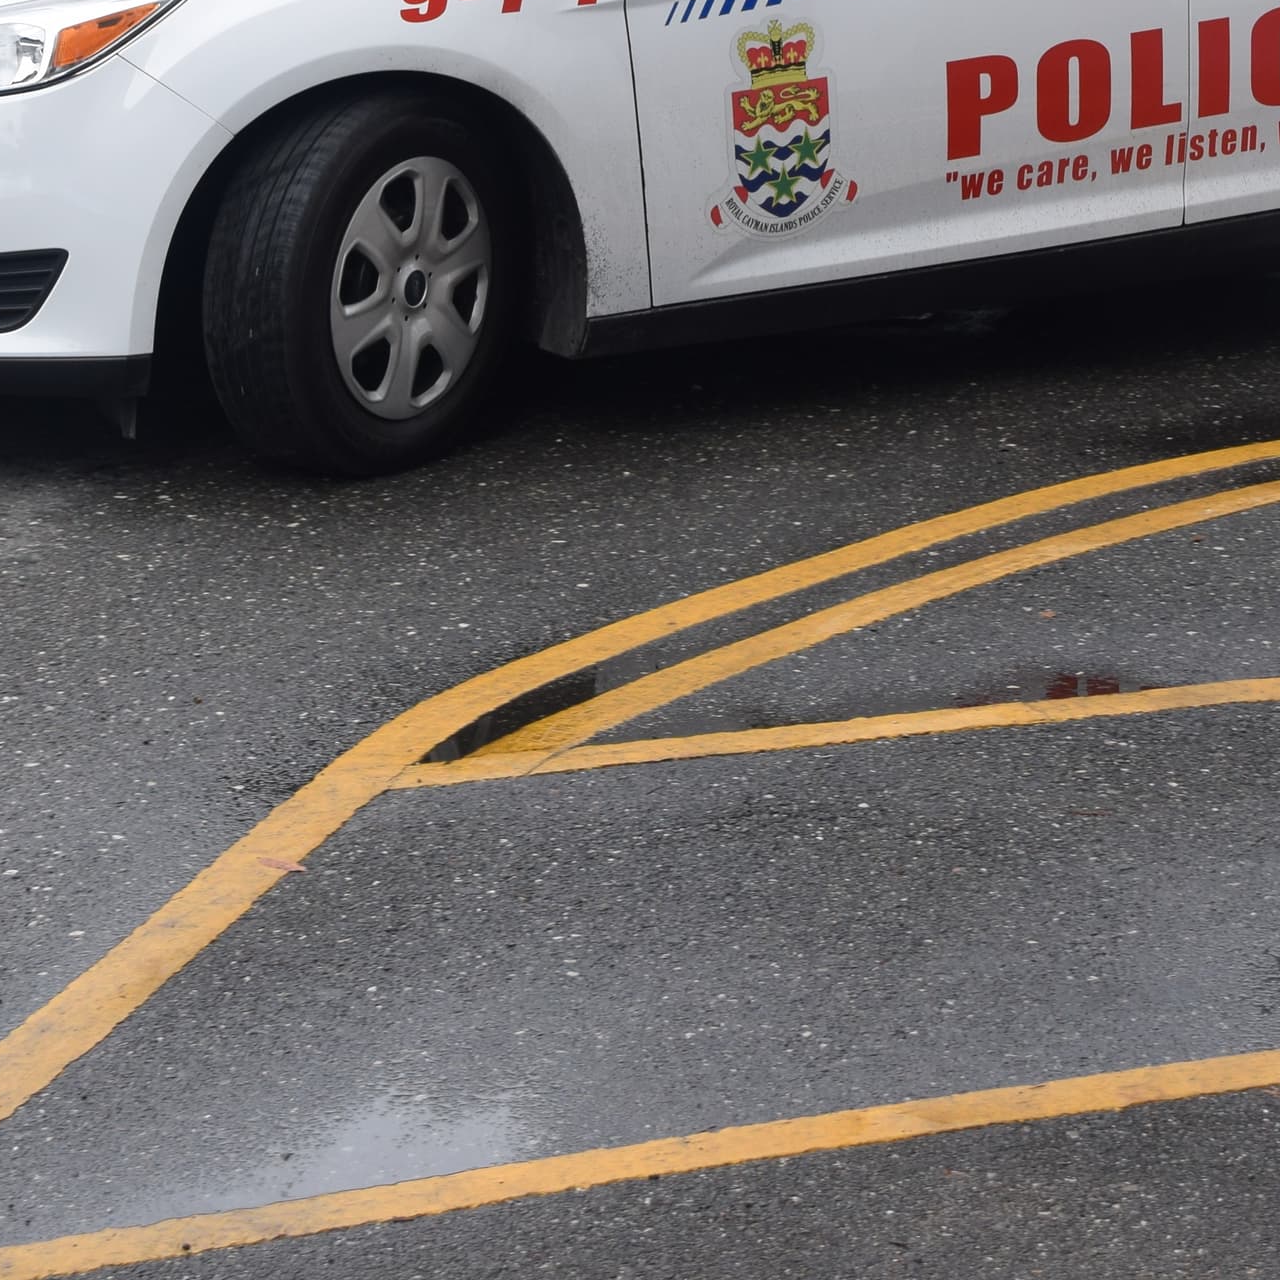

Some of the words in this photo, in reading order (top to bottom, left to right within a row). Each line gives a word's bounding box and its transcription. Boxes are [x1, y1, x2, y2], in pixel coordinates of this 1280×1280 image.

[946, 167, 1003, 201] "we
[1016, 153, 1097, 191] care,
[1110, 143, 1153, 175] we
[1165, 123, 1266, 167] listen,
[725, 198, 742, 221] ROYAL
[741, 215, 769, 233] CAYMAN
[769, 222, 798, 233] ISLANDS
[799, 207, 823, 226] POLICE
[821, 178, 844, 209] SERVICE
